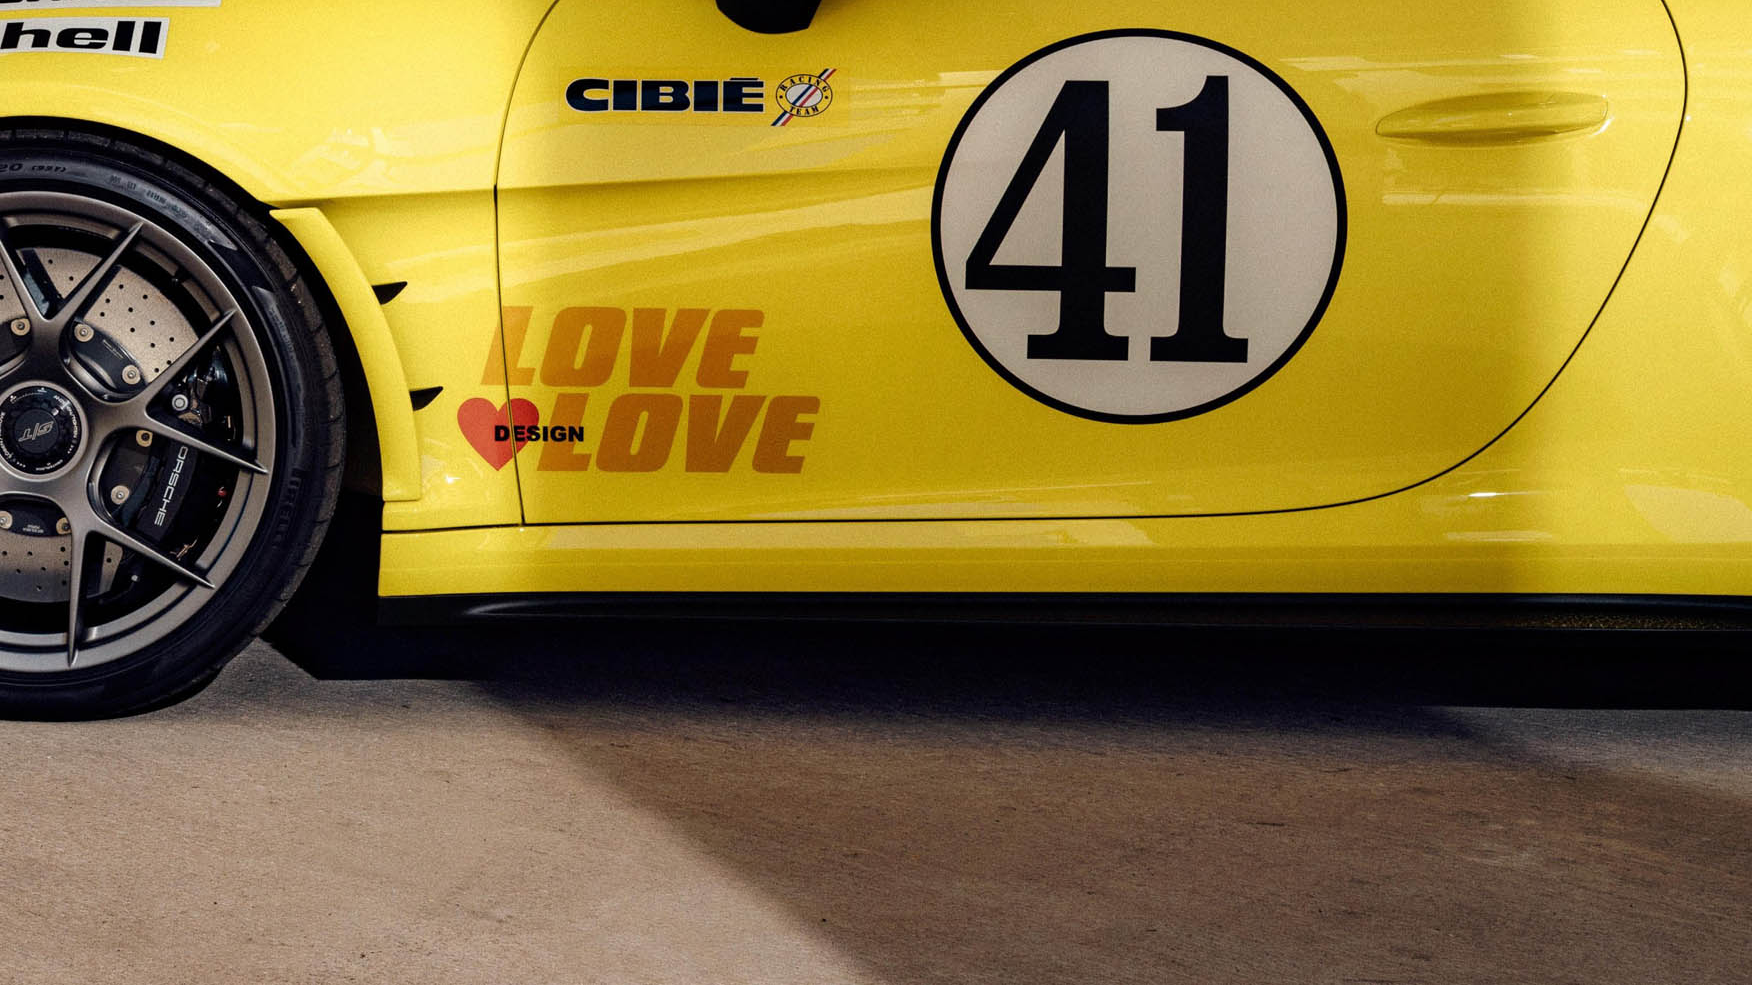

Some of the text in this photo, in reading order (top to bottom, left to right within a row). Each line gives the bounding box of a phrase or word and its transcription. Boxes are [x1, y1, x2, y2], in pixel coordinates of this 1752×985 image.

[779, 75, 830, 93] RACING
[789, 104, 819, 116] TEAM
[964, 74, 1249, 364] 41
[480, 305, 765, 389] LOVE
[494, 425, 585, 443] DESIGN
[536, 392, 822, 475] LOVE
[153, 445, 189, 527] ORSCHE
